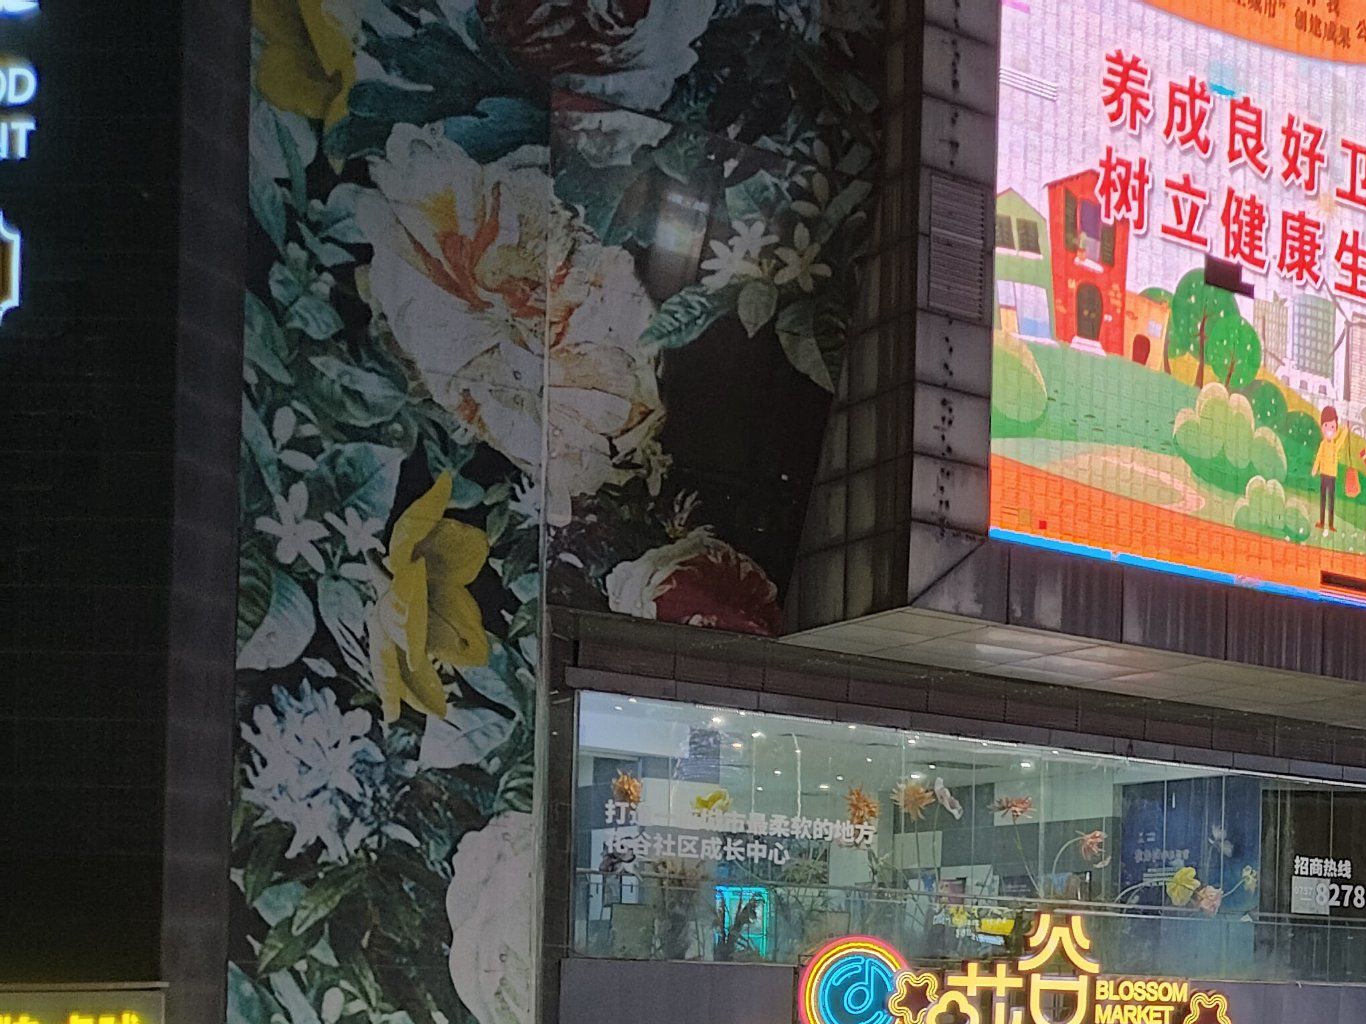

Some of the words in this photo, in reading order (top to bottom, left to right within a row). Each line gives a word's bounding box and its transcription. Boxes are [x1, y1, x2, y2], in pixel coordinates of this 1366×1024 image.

[1294, 856, 1352, 880] 招商热线
[1096, 980, 1188, 1003] BLOSSOM
